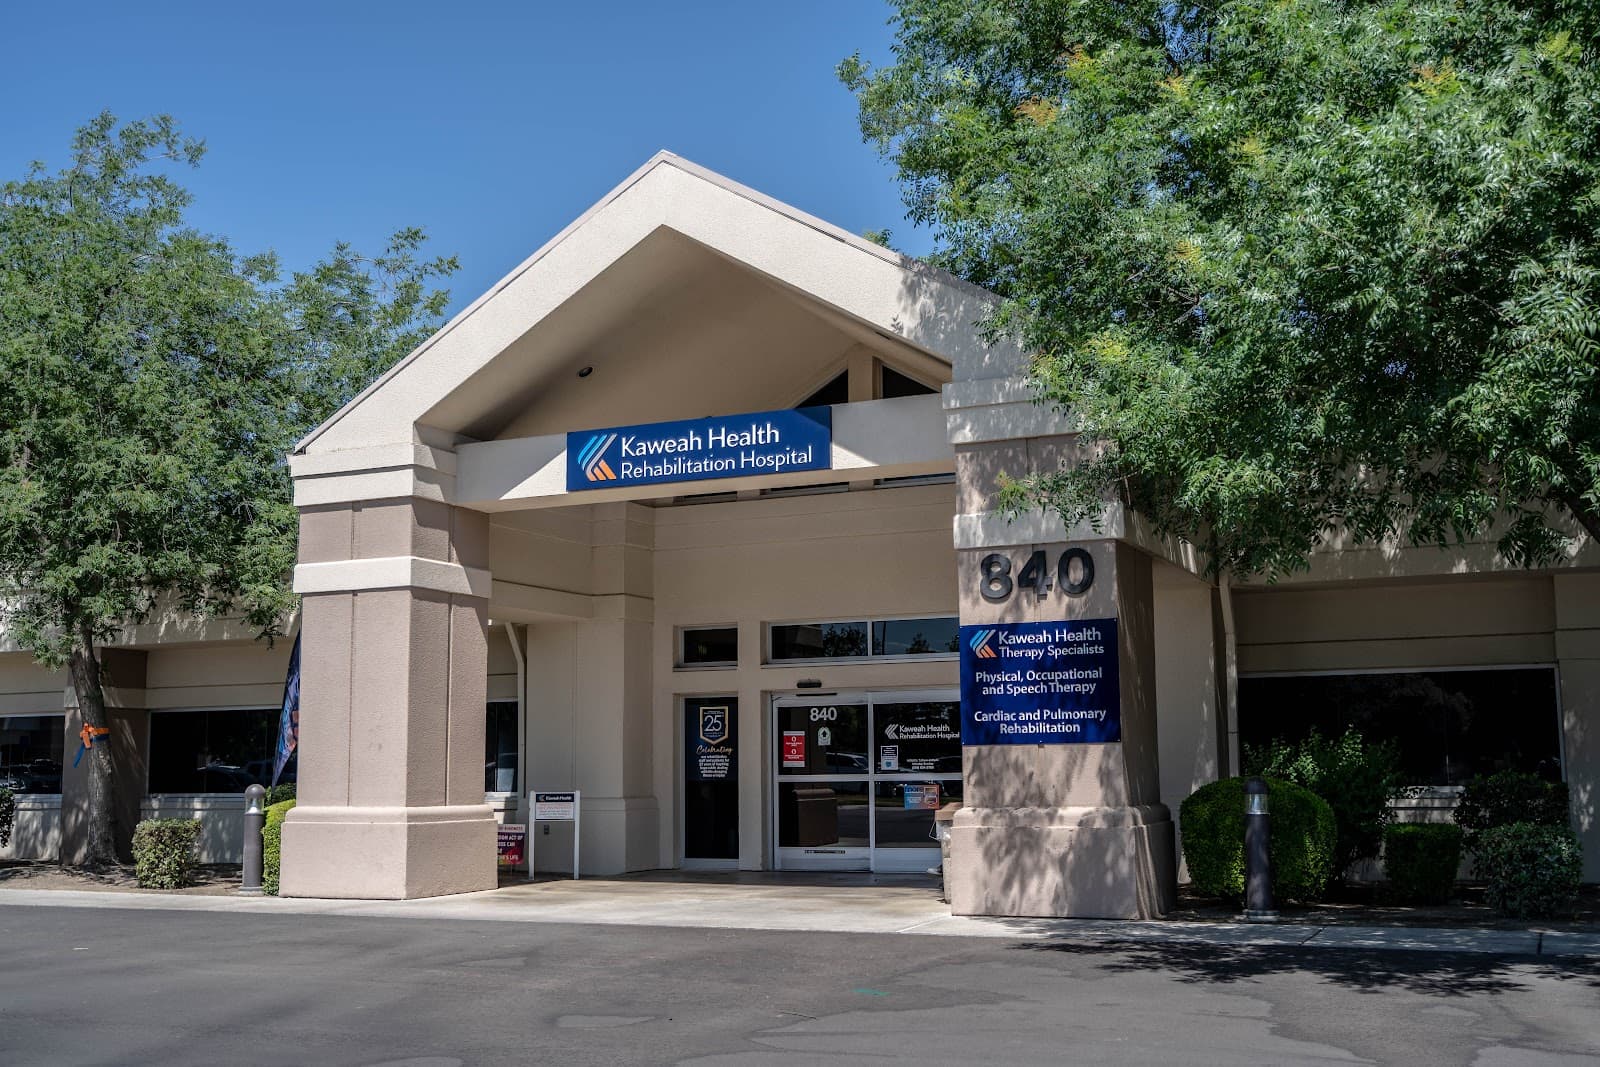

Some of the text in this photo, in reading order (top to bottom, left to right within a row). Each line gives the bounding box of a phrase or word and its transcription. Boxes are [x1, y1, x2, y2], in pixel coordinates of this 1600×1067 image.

[621, 421, 780, 458] Kaweah Health
[621, 445, 812, 479] Rehabilitation Hospital
[980, 548, 1095, 600] 840
[998, 627, 1101, 645] Kaweah Health
[998, 644, 1105, 660] Therapy Specialists
[975, 667, 1103, 685] Physical, Occupational
[982, 682, 1096, 696] and Speech Therapy
[810, 707, 837, 722] 840
[974, 709, 1107, 722] Cardiac and Pulmonary
[703, 715, 723, 732] 25
[899, 723, 950, 733] Kaweah Health
[1000, 722, 1080, 734] Rehabilitation
[899, 731, 961, 741] Rehabilitation Hospital
[696, 745, 734, 755] Celebrating
